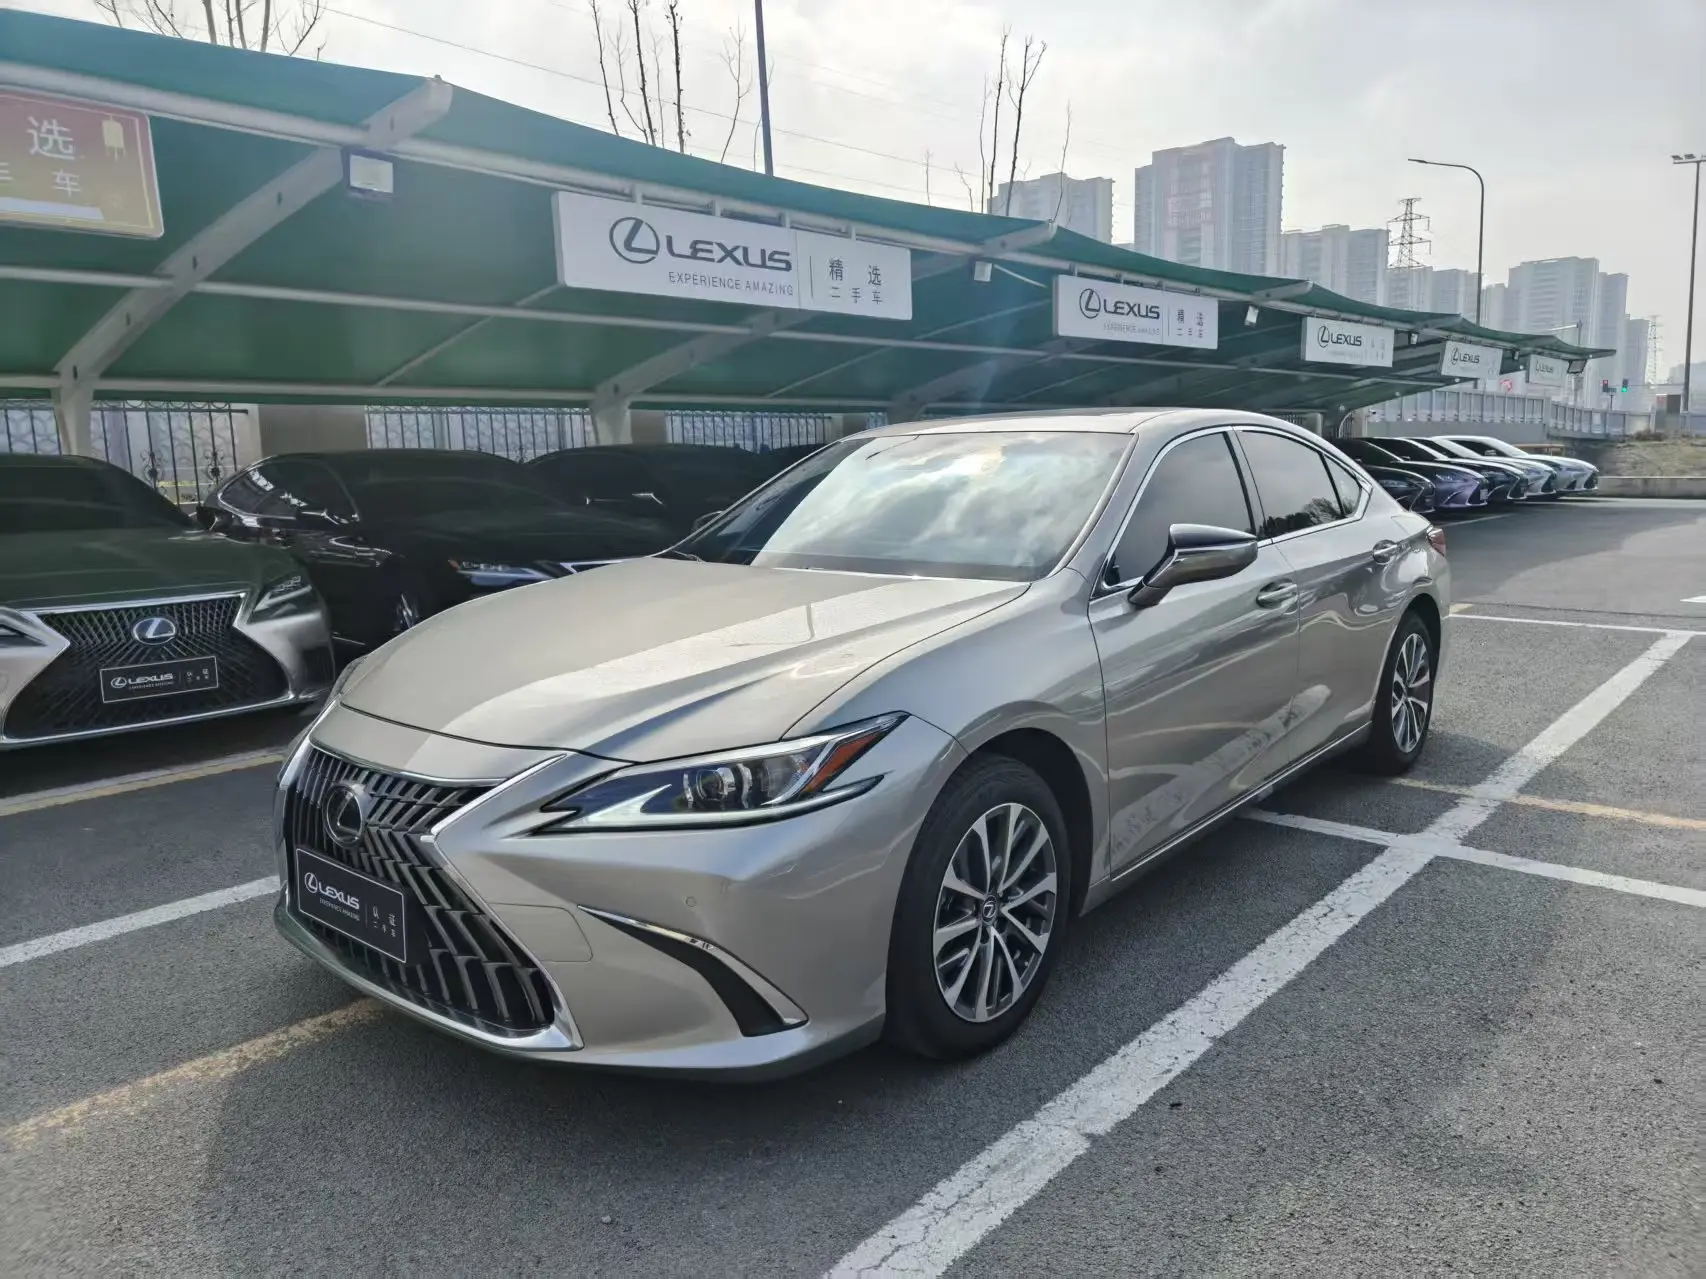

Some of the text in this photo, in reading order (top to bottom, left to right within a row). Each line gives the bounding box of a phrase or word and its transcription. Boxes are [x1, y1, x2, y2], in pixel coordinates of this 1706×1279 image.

[26, 115, 76, 160] 选
[665, 235, 793, 272] LEXUS
[668, 271, 794, 296] EXPERIENCE AMAZING
[828, 257, 882, 286] 精选
[831, 286, 883, 304] 二手车
[1103, 299, 1161, 320] LEXUS
[1330, 332, 1362, 347] LEXUS
[128, 673, 174, 685] LEXUS
[318, 881, 360, 910] LEXUS
